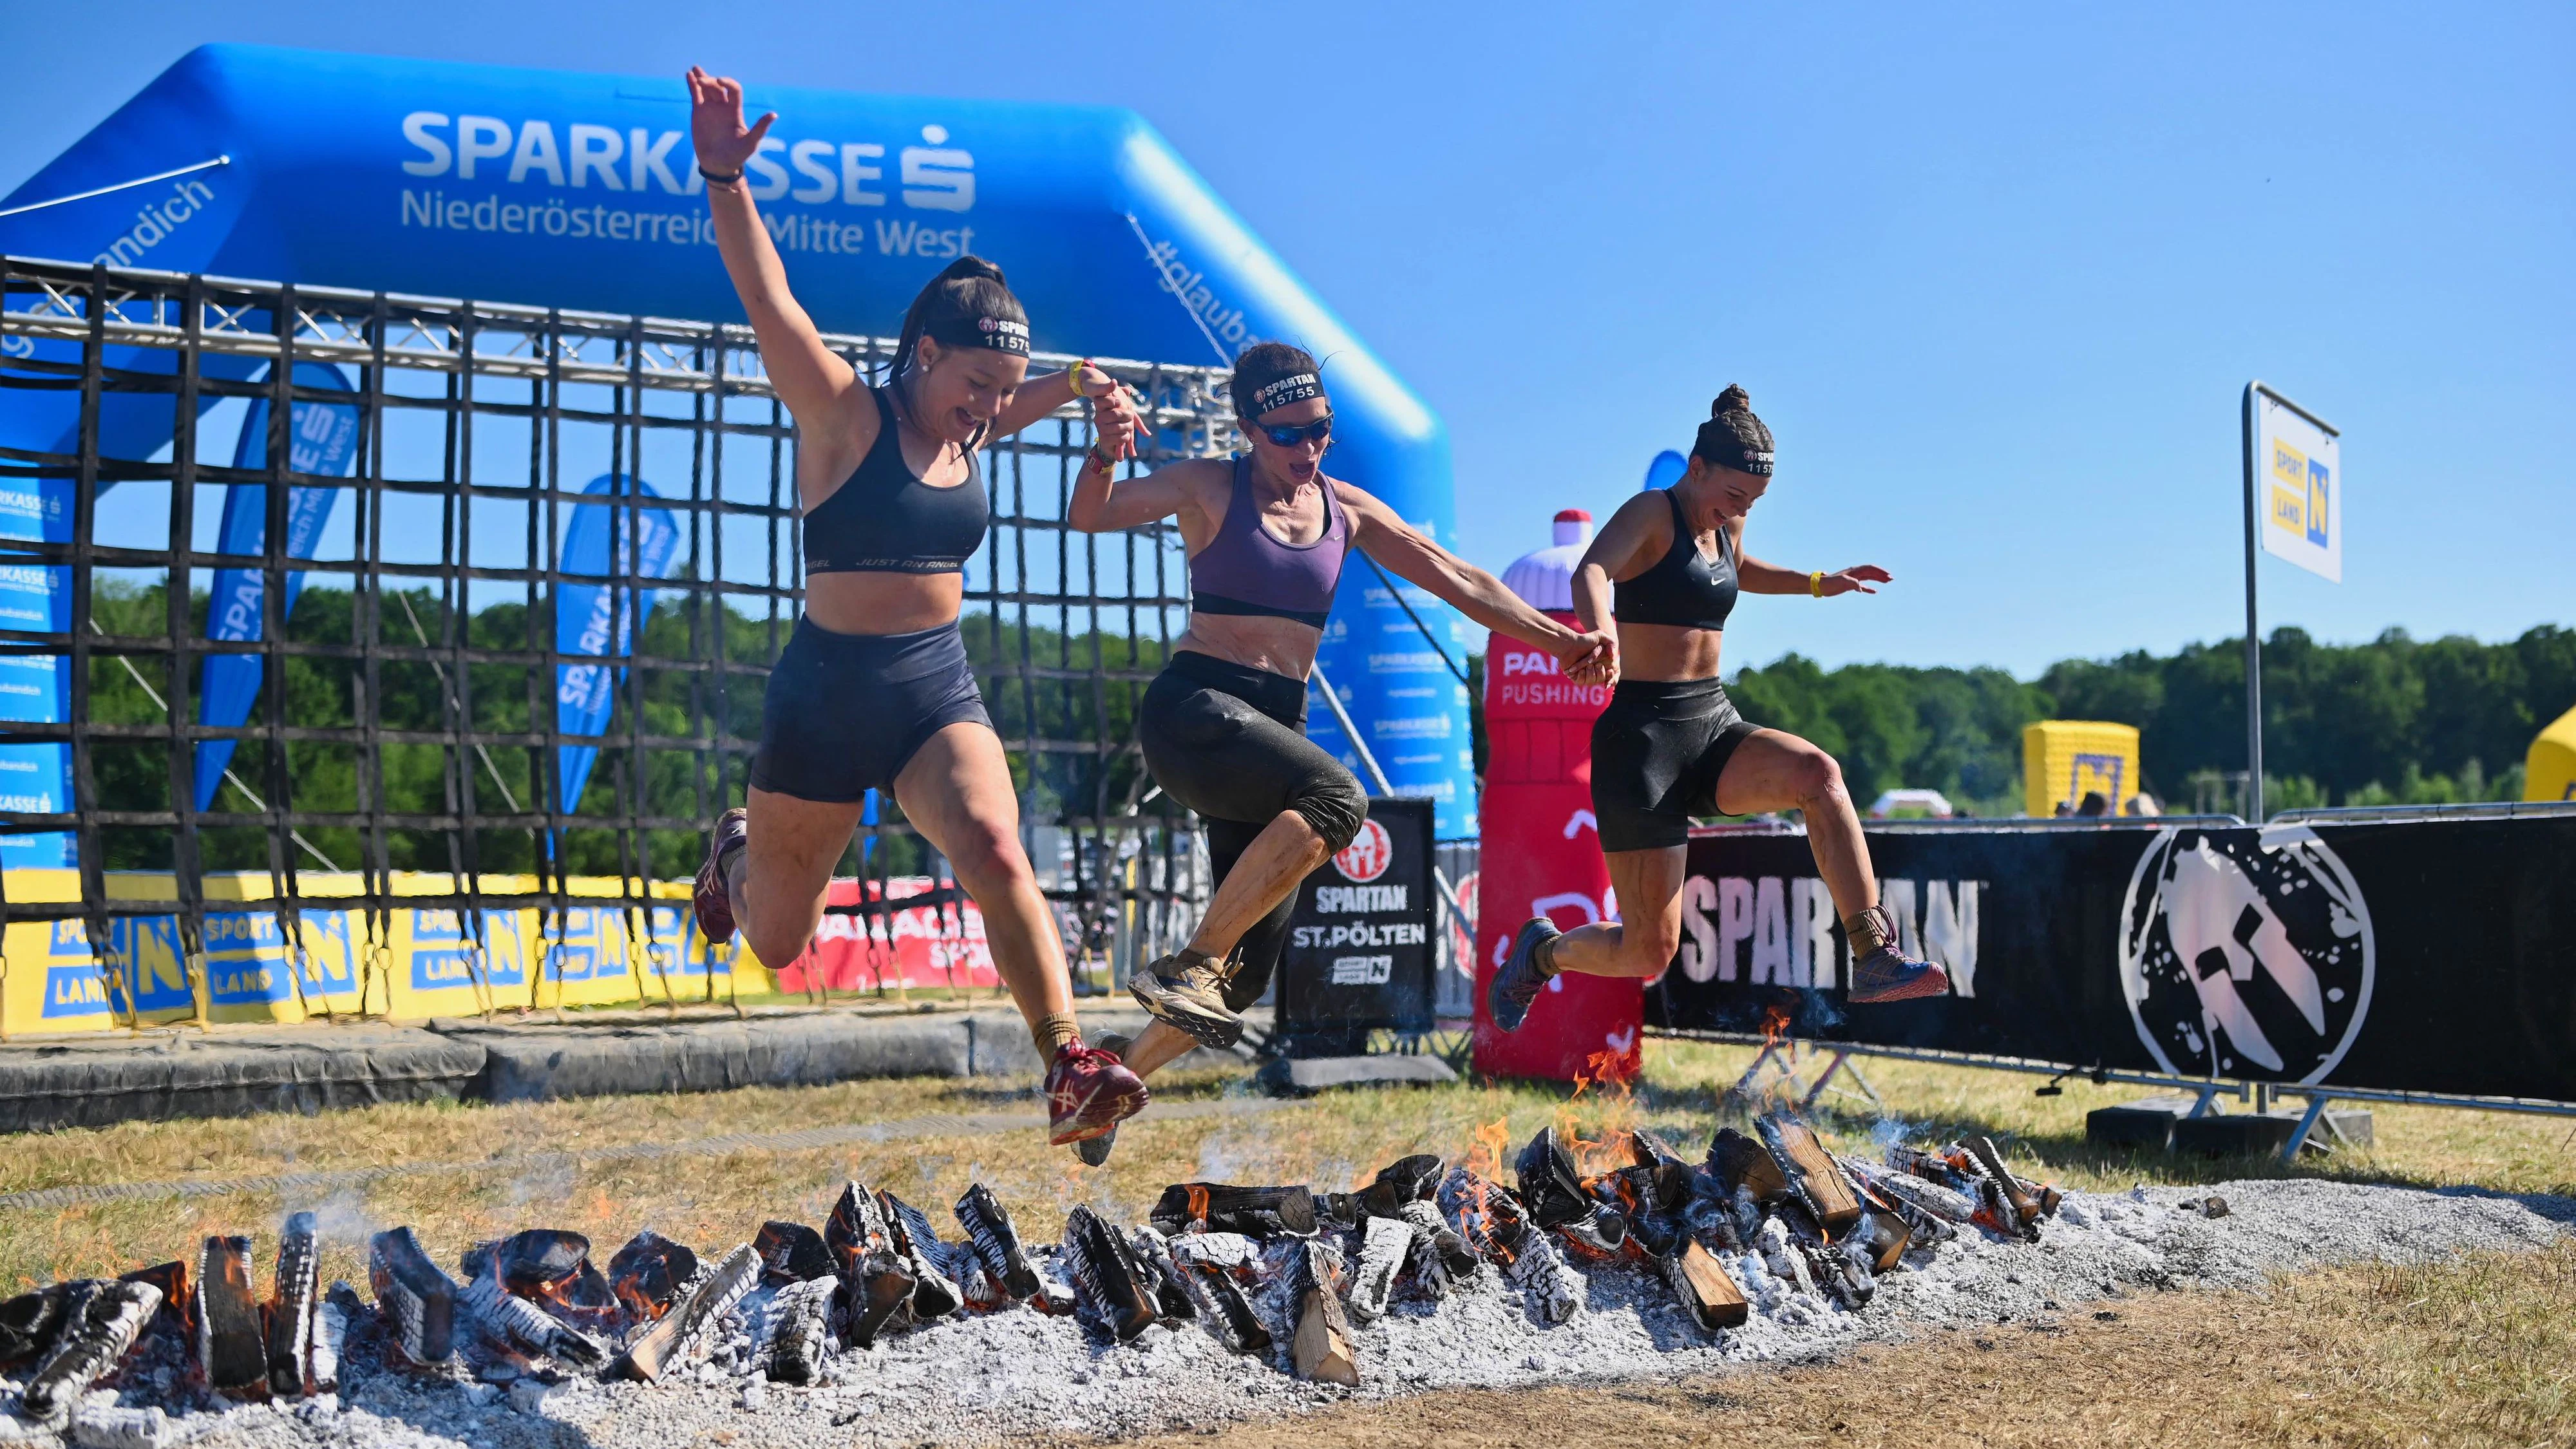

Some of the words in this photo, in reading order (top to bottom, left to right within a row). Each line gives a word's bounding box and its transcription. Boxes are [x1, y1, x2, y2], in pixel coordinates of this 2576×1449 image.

[401, 189, 718, 245] Niederösterreic
[764, 211, 864, 254] Mitte
[875, 218, 976, 257] West
[1265, 374, 1316, 397] SPARTAN
[1262, 386, 1314, 412] 115755
[1748, 463, 1774, 474] 1157
[1757, 452, 1774, 462] SPA
[2277, 449, 2303, 480] SPORT
[2277, 497, 2300, 525] LAND
[856, 558, 898, 567] JUST
[1502, 682, 1605, 706] PUSHING
[1316, 884, 1408, 913] SPARTAN
[204, 915, 276, 942] SPORT
[1680, 873, 1979, 999] SPARAN
[213, 969, 273, 995] LAND
